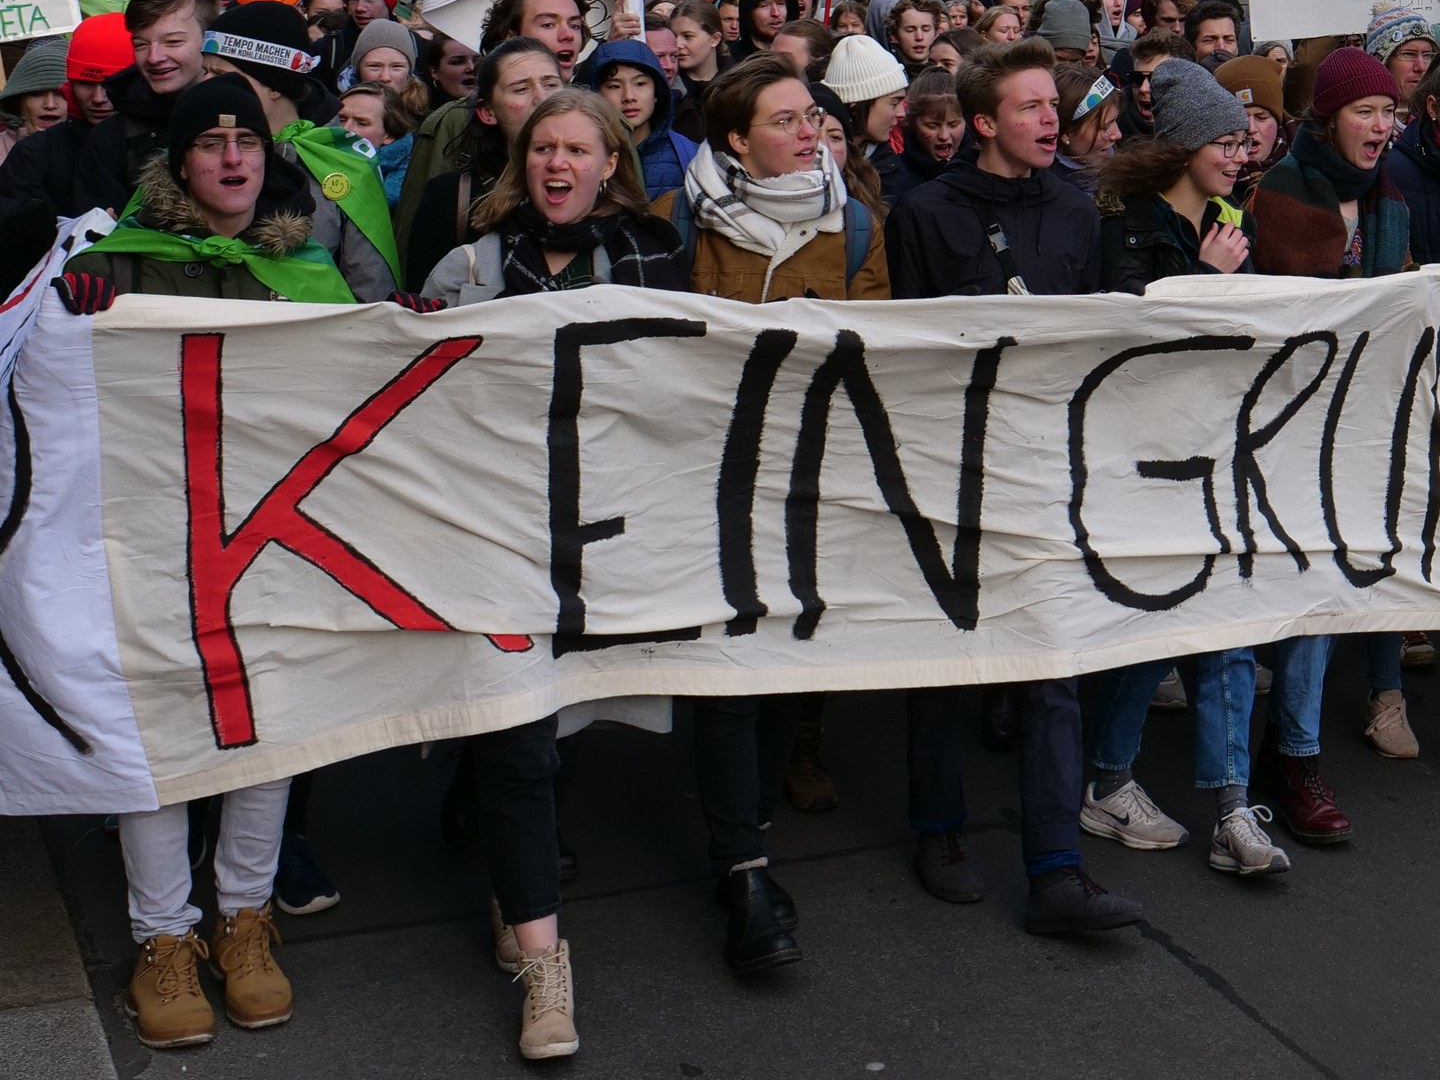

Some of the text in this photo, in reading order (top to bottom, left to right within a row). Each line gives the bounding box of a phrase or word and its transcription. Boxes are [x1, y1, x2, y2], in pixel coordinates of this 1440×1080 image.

[0, 3, 51, 38] ETA
[220, 46, 237, 56] BEIM
[223, 35, 254, 51] TEMPO
[255, 43, 292, 59] MACHEN
[181, 318, 1017, 750] KEIN
